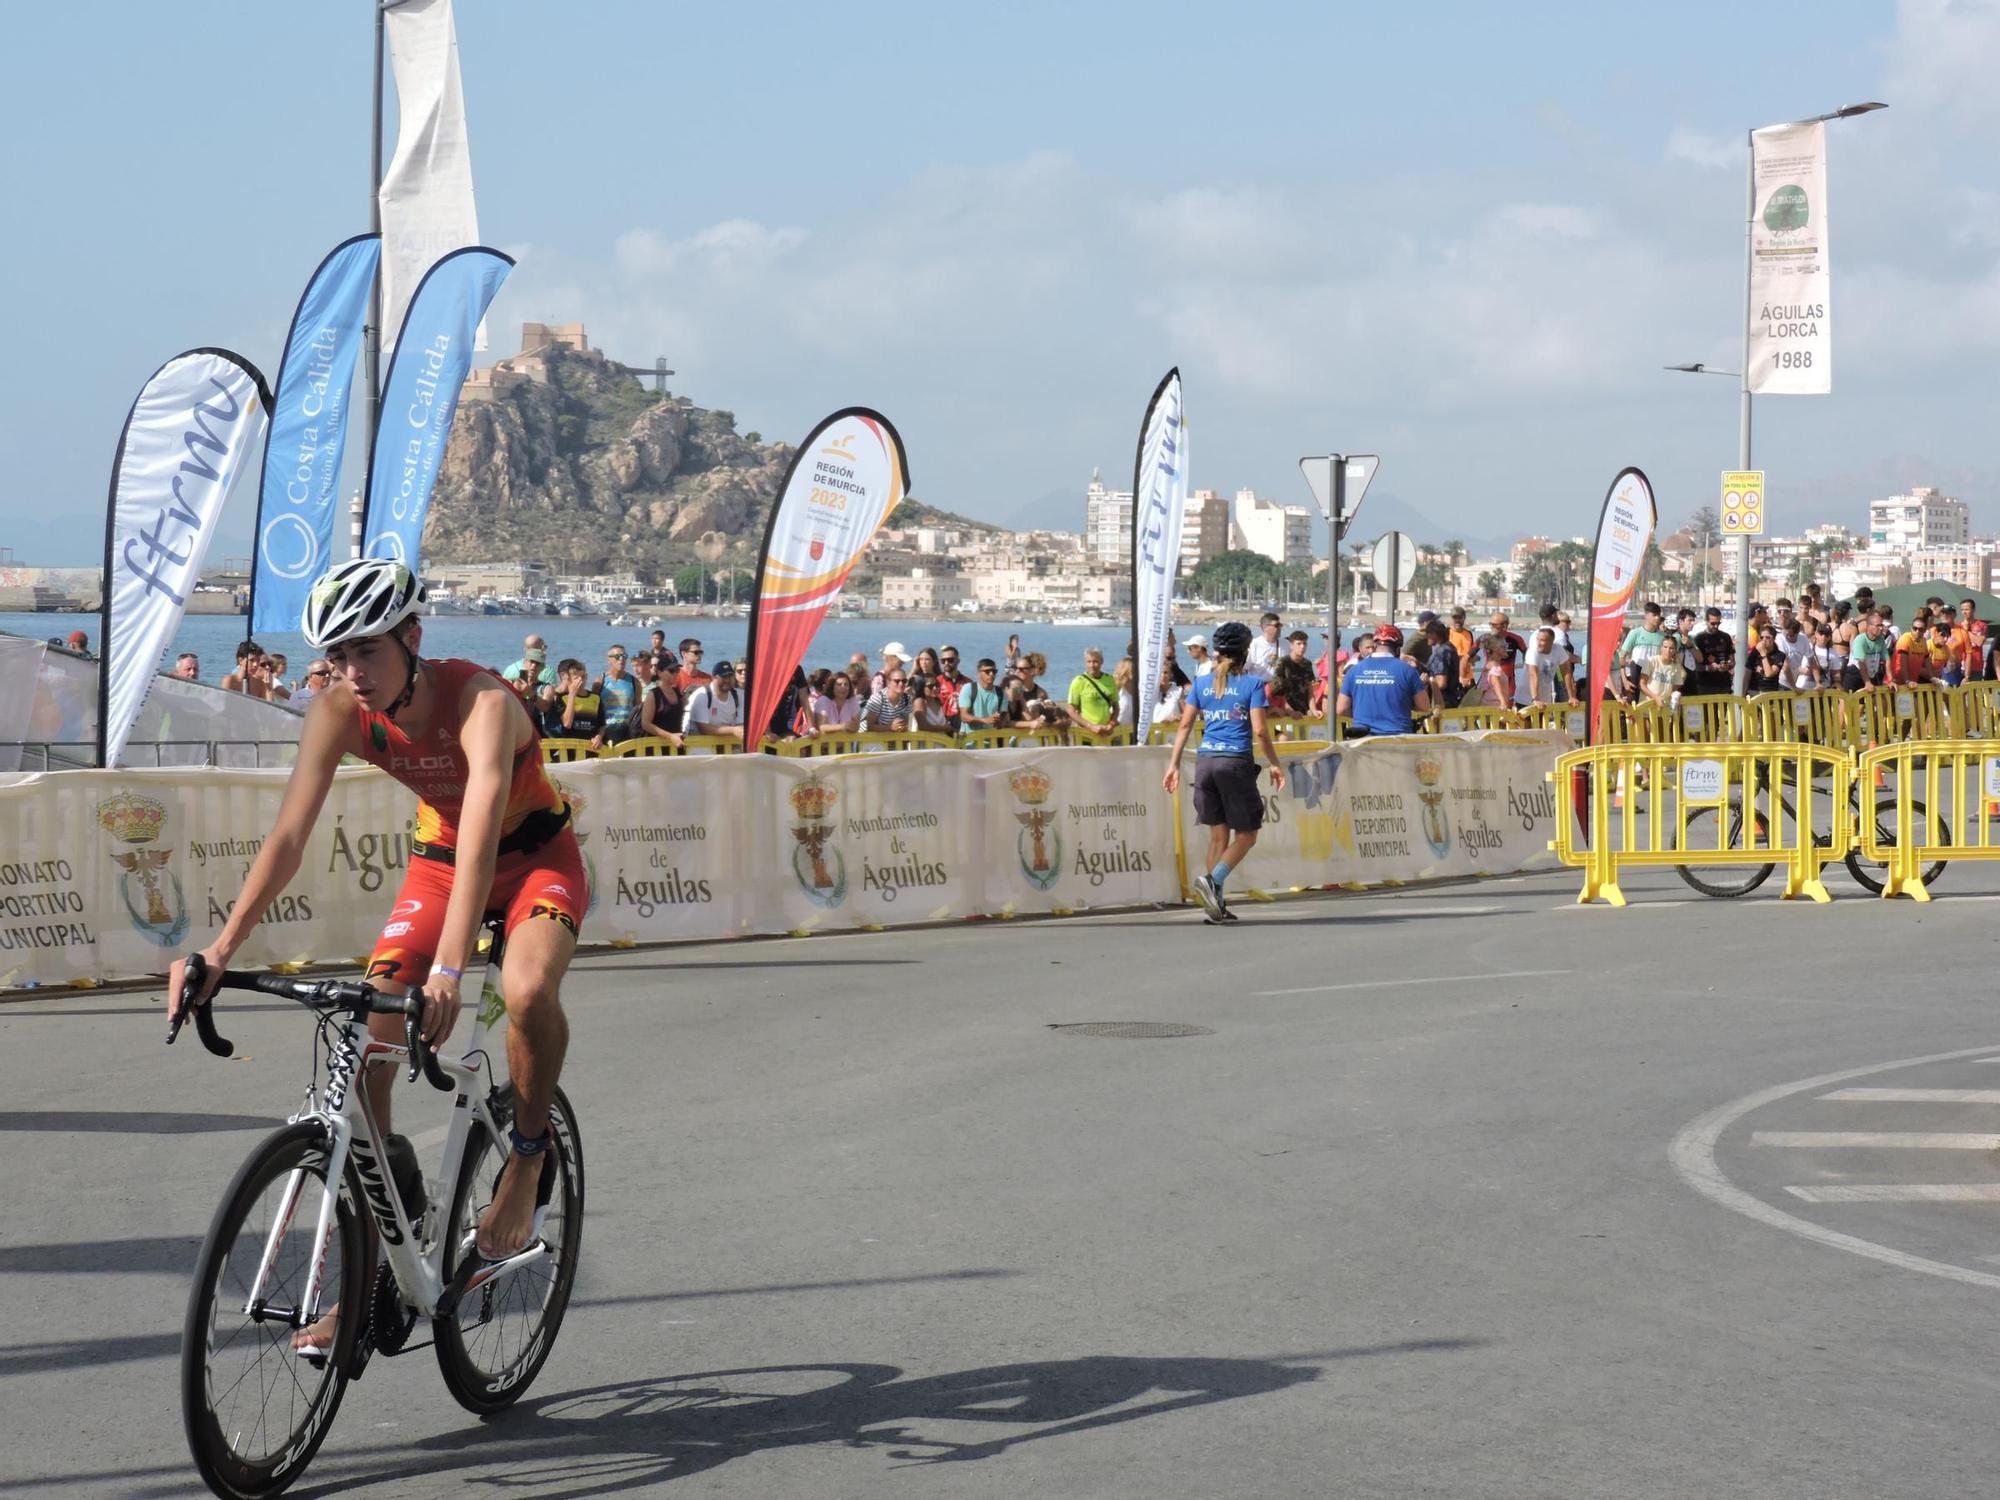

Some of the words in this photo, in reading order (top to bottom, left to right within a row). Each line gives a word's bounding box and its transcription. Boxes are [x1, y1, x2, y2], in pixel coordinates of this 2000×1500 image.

[1760, 302, 1824, 320] ÁGUILAS
[1768, 322, 1818, 338] LORCA
[302, 326, 338, 418] Cálida
[1771, 351, 1812, 369] 1988
[392, 439, 421, 521] Costa
[409, 334, 451, 428] Cálida
[288, 426, 319, 505] Costa
[816, 461, 854, 479] REGIÓN
[813, 473, 827, 486] DE
[827, 477, 866, 496] MURCIA
[810, 487, 848, 512] 2023
[1148, 593, 1165, 650] Triatlón
[1203, 687, 1239, 697] OFIAL
[391, 754, 456, 770] FLOR
[1067, 800, 1147, 825] Ayuntamiento
[1351, 793, 1403, 811] PATRONATO
[1471, 804, 1481, 821] de
[1507, 778, 1557, 831] Águil
[604, 823, 706, 849] Ayuntamiento
[847, 811, 938, 840] Ayuntamiento
[1103, 822, 1117, 841] de
[1354, 817, 1407, 836] DEPORTIVO
[189, 834, 266, 867] Ayuntami
[890, 834, 906, 854] de
[1358, 840, 1411, 859] MUNICIPAL
[1458, 820, 1503, 858] Águilas
[328, 815, 413, 892] Águi
[649, 847, 668, 868] de
[1075, 840, 1152, 886] Águilas
[0, 859, 72, 886] ONATO
[863, 852, 947, 902] Águilas
[615, 867, 712, 918] Águilas
[0, 923, 96, 950] UNICIPAL
[486, 1326, 546, 1392] ZIPP
[272, 1366, 338, 1478] ZIPP
